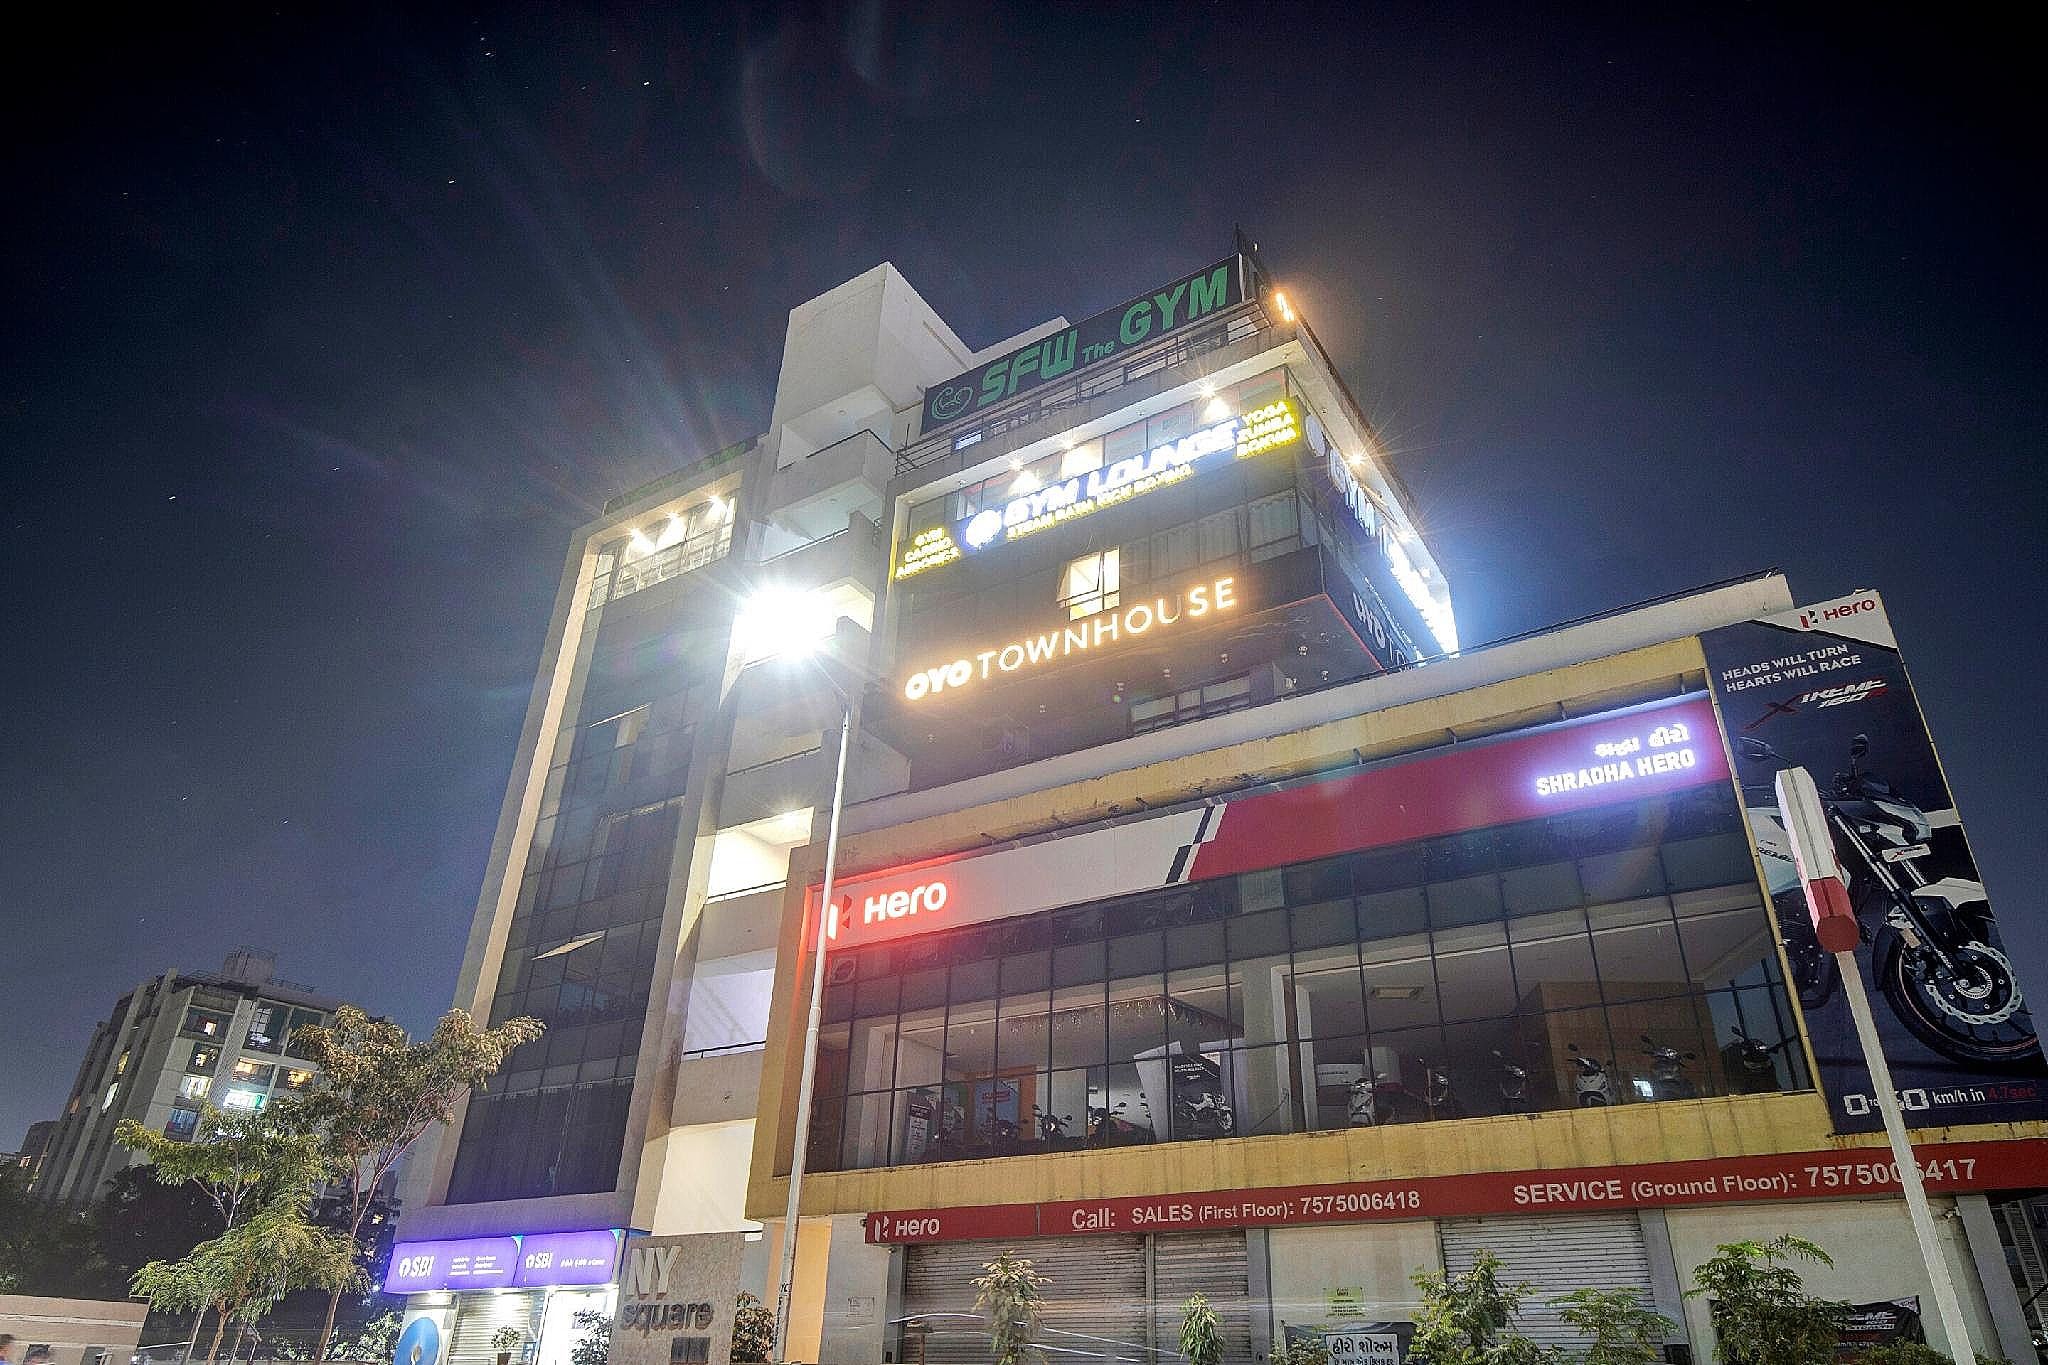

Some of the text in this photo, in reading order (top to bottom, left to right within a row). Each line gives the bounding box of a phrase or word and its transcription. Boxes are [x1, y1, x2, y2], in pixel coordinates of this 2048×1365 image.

[977, 266, 1229, 408] SFW The GYM
[1003, 477, 1080, 528] GYM
[1823, 599, 1876, 620] Hero
[904, 577, 1235, 700] OYO TOWNHOUSE
[1722, 644, 1848, 681] HEADS WILL TURN
[1725, 655, 1862, 692] HEARTS WILL RACE
[1536, 749, 1696, 796] SHRADHA HERO
[863, 882, 947, 924] Hero
[1844, 1094, 1870, 1115] 0
[1932, 1091, 1968, 1105] km/h
[1969, 1088, 1986, 1101] in
[896, 1218, 940, 1236] Hero
[1072, 1208, 1116, 1231] Call:
[1132, 1204, 1193, 1225] SALES
[1199, 1205, 1238, 1223] (First
[1242, 1201, 1294, 1220] Floor):
[1301, 1190, 1420, 1214] 7575006418
[1513, 1180, 1624, 1204] SERVICE
[1631, 1178, 1717, 1201] (Ground
[1723, 1172, 1797, 1194] Floor):
[410, 1256, 435, 1278] SBI
[535, 1252, 553, 1269] SBI
[626, 1245, 682, 1296] NY
[623, 1303, 714, 1337] square
